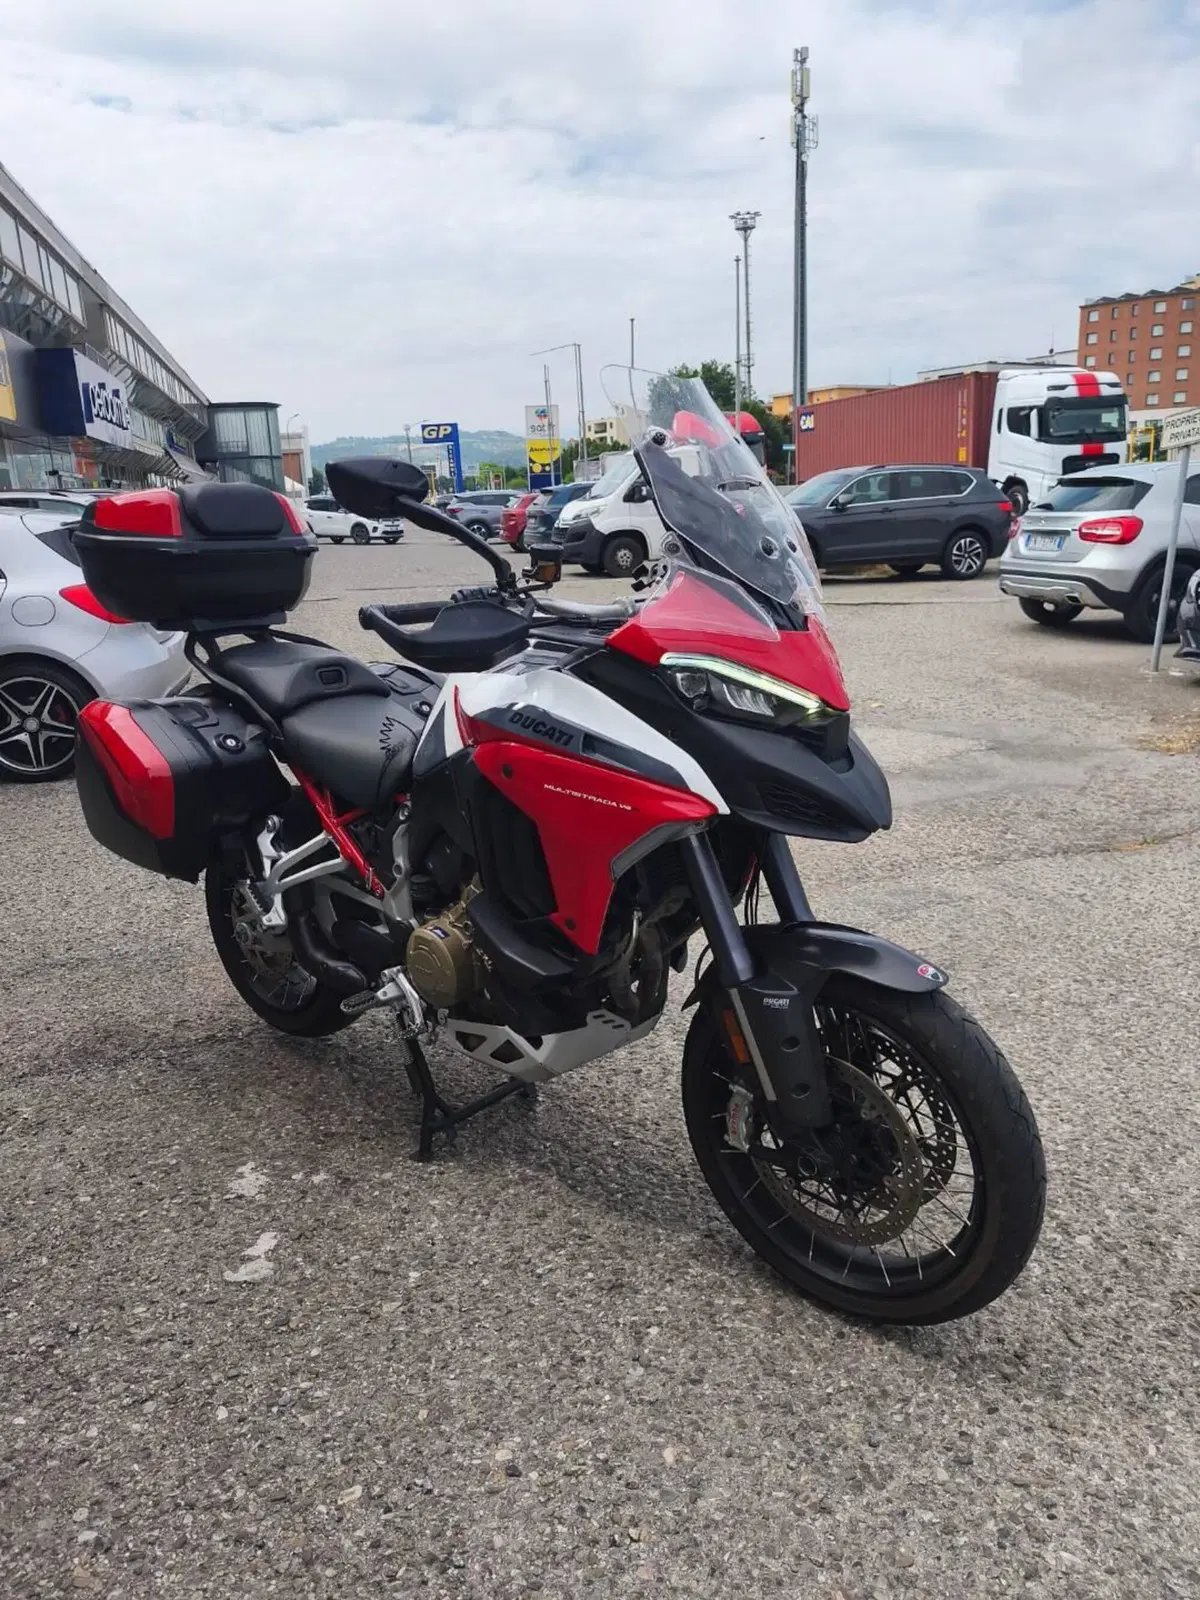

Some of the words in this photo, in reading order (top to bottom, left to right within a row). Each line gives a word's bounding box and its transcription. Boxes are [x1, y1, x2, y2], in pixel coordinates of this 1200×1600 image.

[1165, 414, 1200, 430] PROPRIE
[423, 425, 451, 438] GP
[509, 712, 575, 746] DUCATI
[544, 784, 618, 807] MULTISTRADA
[763, 997, 790, 1006] DUCATI
